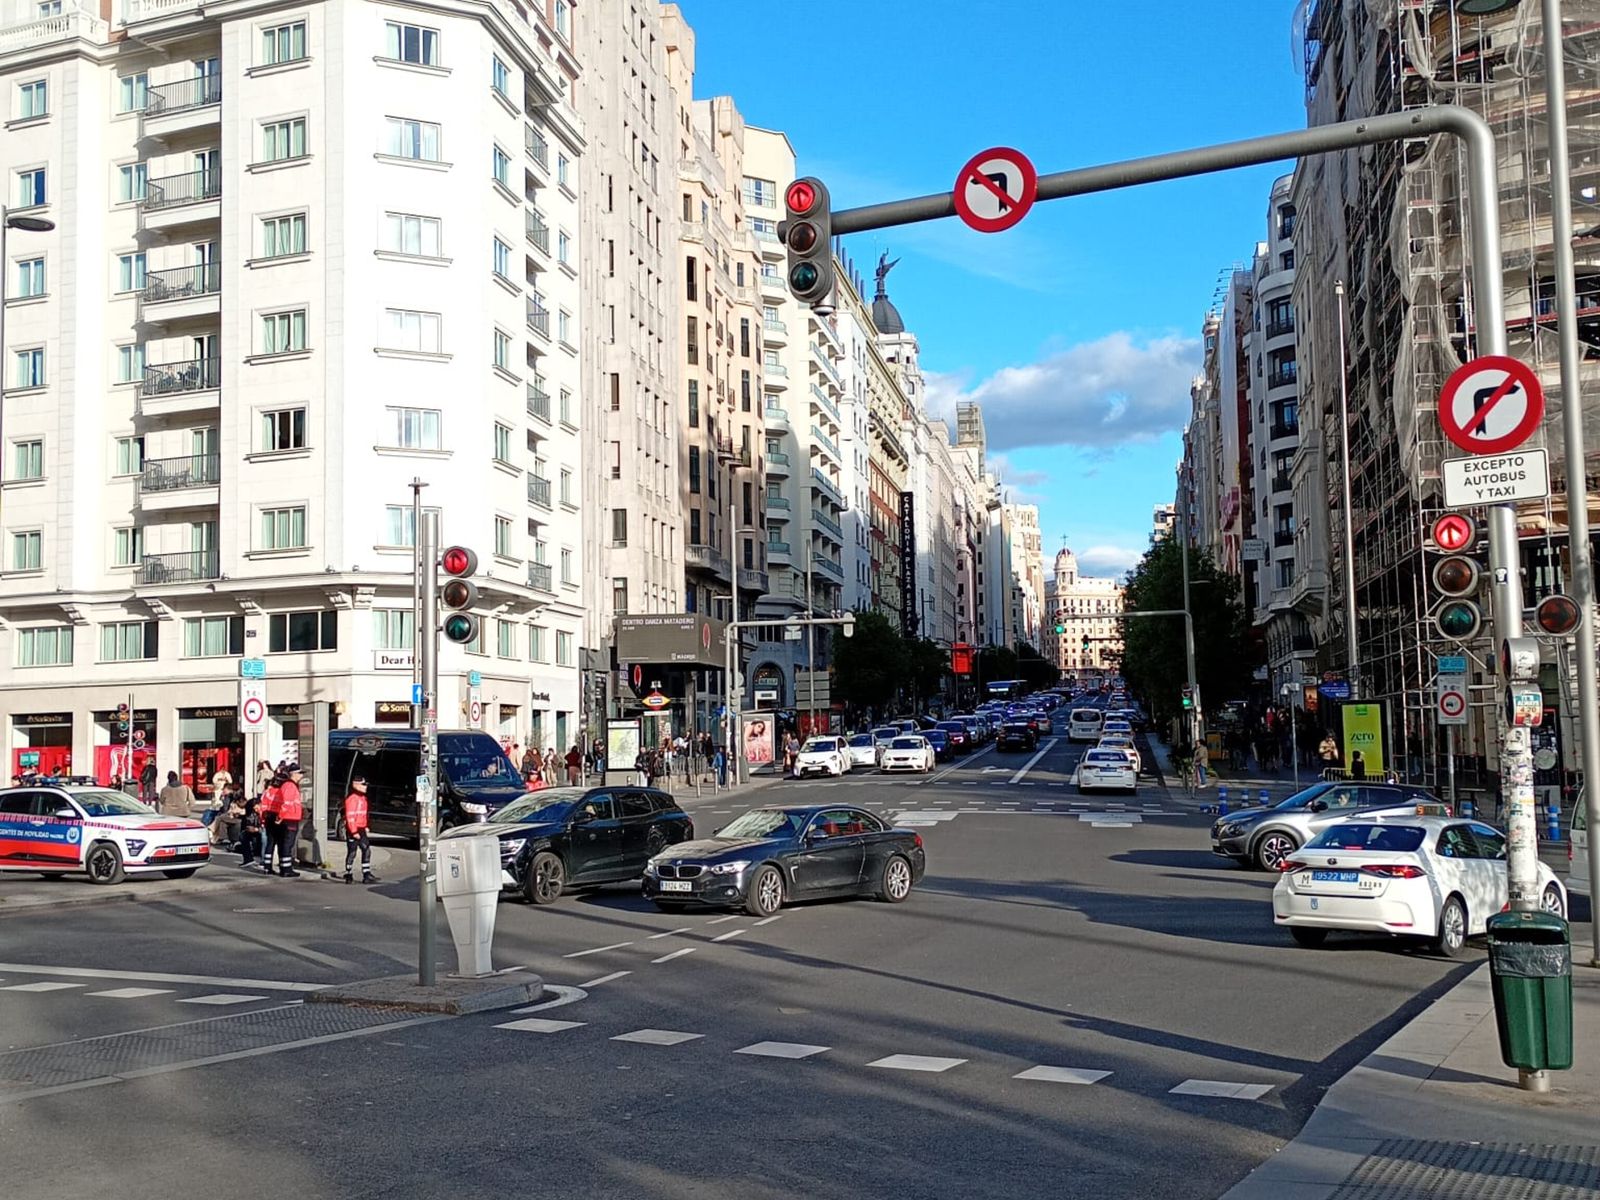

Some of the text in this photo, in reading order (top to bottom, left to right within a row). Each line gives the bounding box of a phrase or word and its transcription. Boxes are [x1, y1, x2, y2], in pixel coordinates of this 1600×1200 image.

[1464, 457, 1524, 473] EXCEPTO
[1463, 470, 1526, 486] AUTOBUS
[1476, 486, 1515, 499] Y TAXI
[381, 655, 404, 665] Dear
[1350, 732, 1374, 741] zero
[17, 829, 23, 837] DE
[1301, 874, 1309, 884] M
[1317, 871, 1338, 880] 9522
